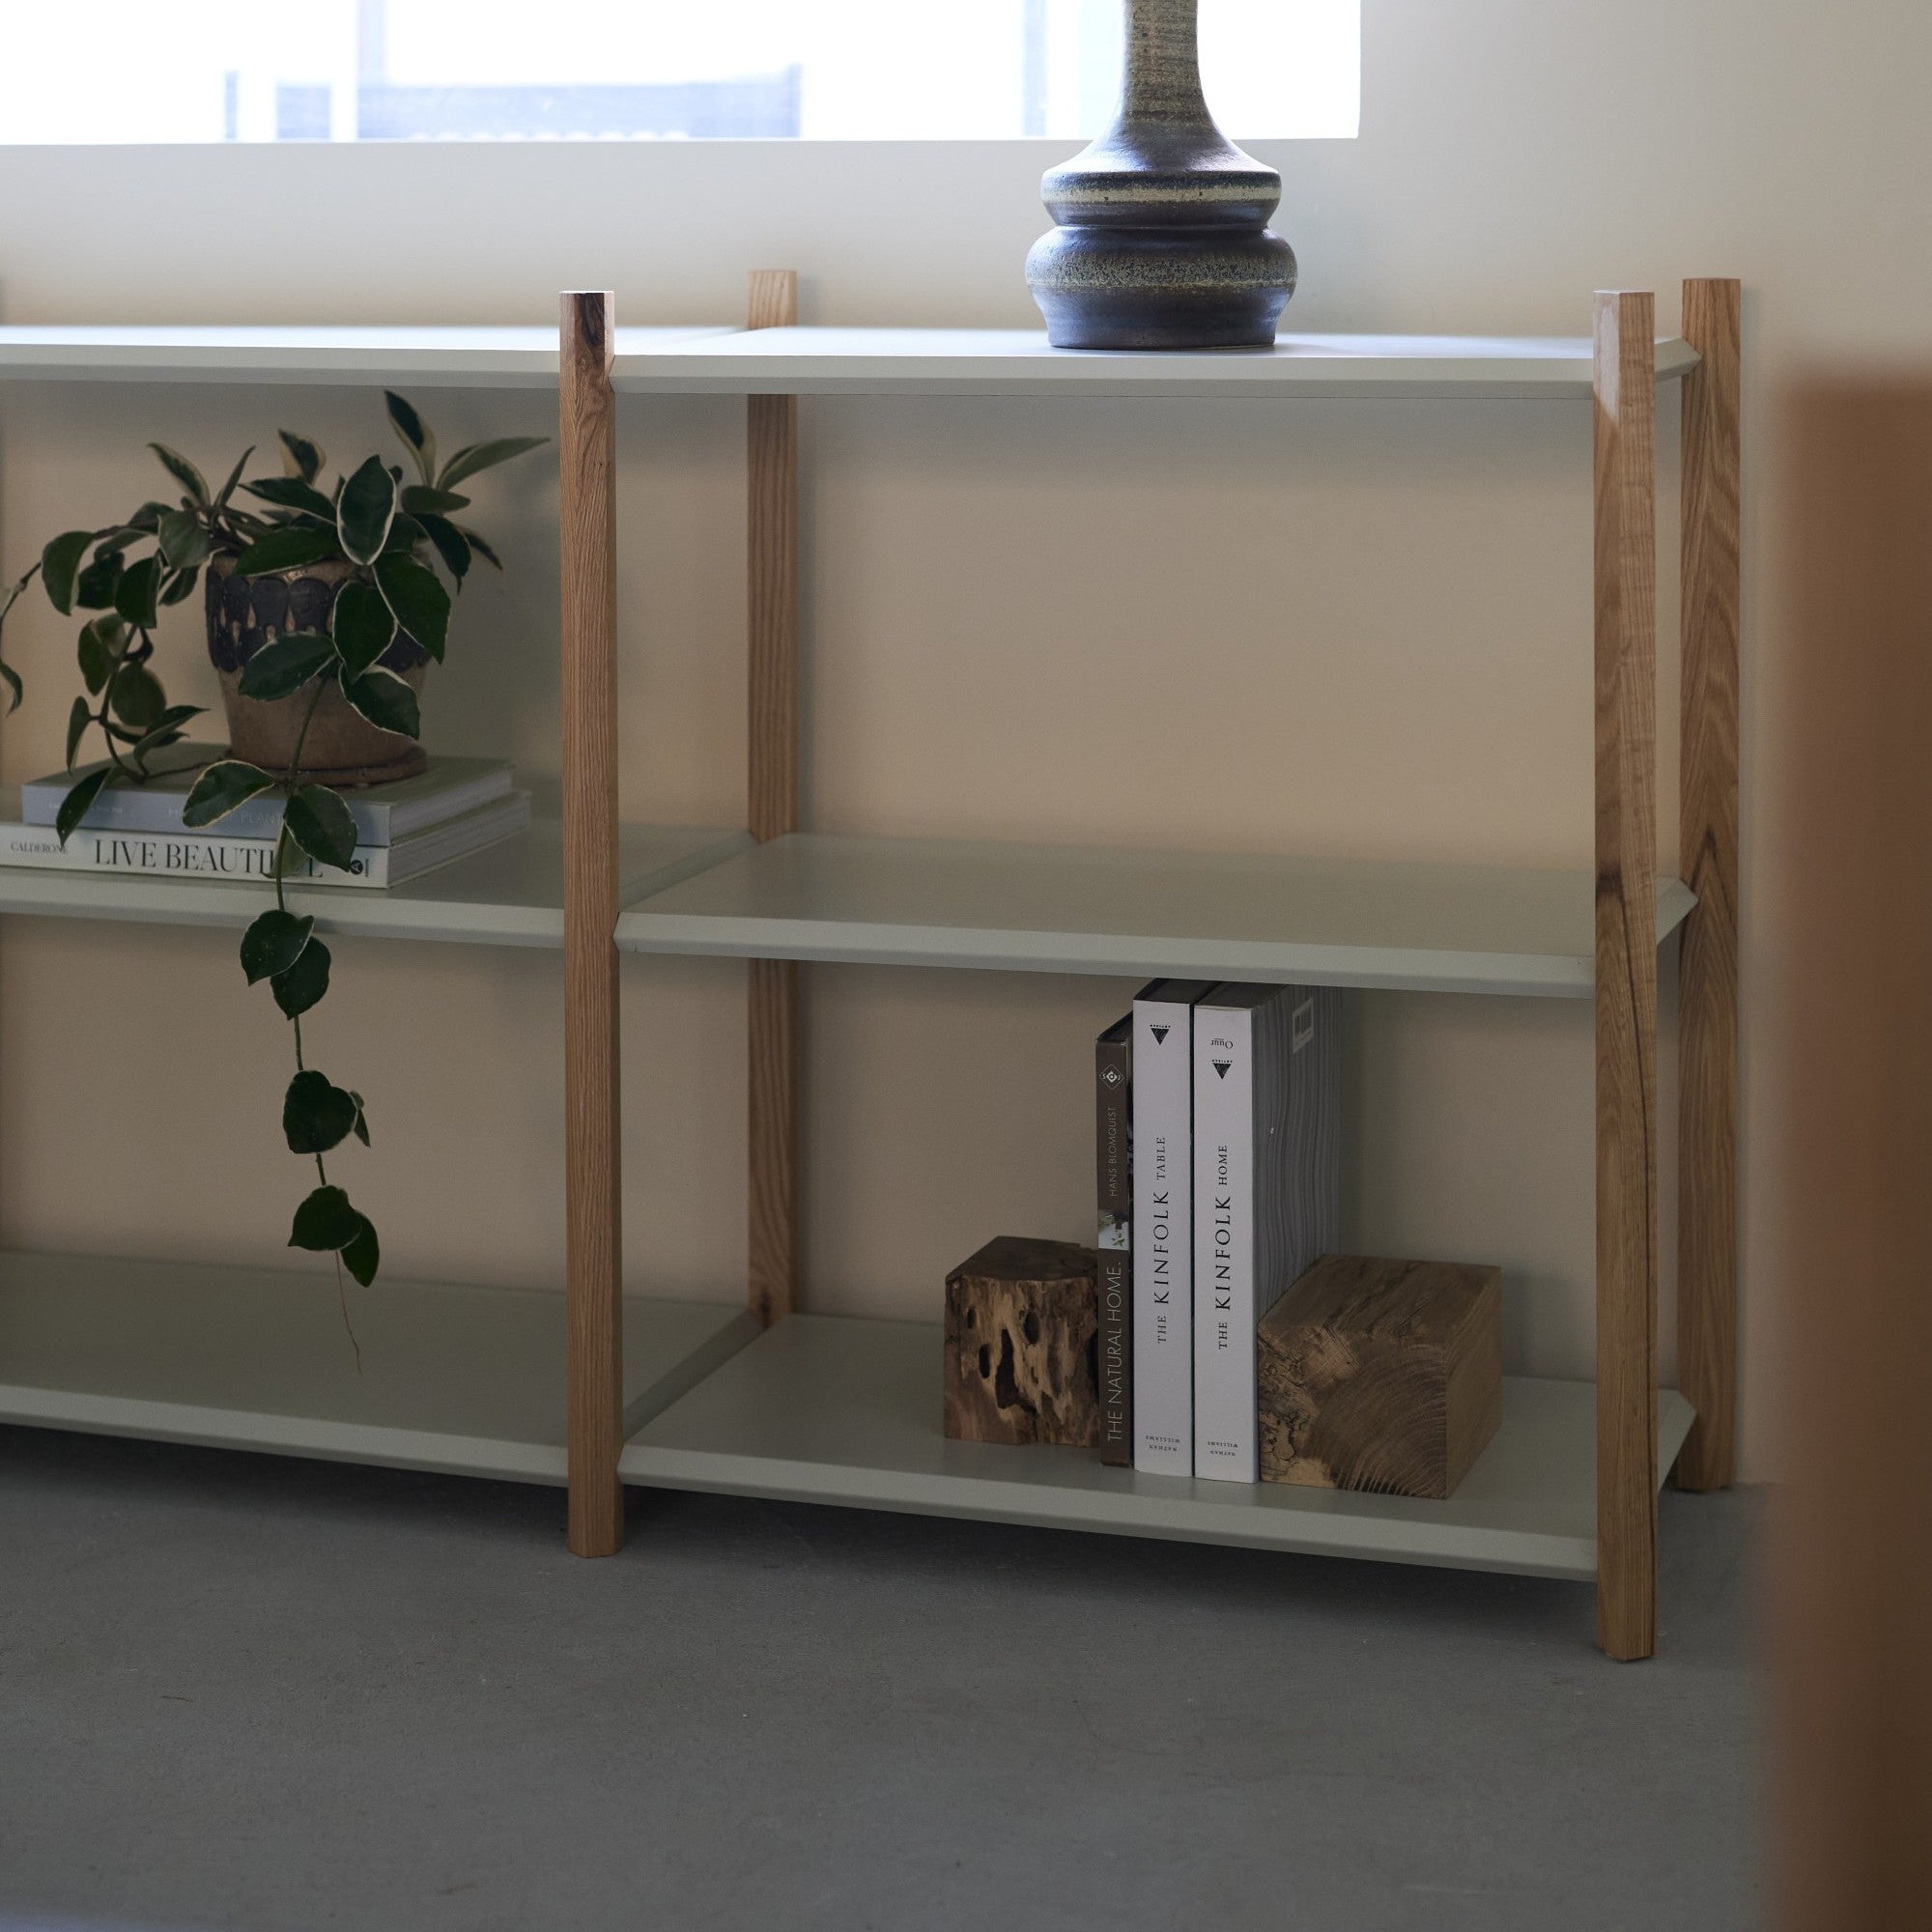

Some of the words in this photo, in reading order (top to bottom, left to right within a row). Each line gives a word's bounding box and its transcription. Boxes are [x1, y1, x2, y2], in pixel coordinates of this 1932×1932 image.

[96, 839, 156, 867] LIVE
[165, 842, 323, 878] BEAUTIL
[1210, 1038, 1234, 1050] Ouur
[1108, 1107, 1118, 1164] BLOMQUIST
[1155, 1137, 1166, 1180] TABLE
[1217, 1145, 1228, 1186] HOME
[1109, 1168, 1119, 1197] HANS
[1153, 1191, 1169, 1305] KINFOLK
[1215, 1196, 1231, 1311] KINFOLK
[1106, 1262, 1122, 1321] HOME.
[1157, 1316, 1167, 1344] THE
[1218, 1321, 1228, 1350] THE
[1107, 1328, 1122, 1405] NATURAL
[1107, 1410, 1122, 1442] THE
[1145, 1435, 1180, 1444] WILLIAMS
[1207, 1440, 1238, 1449] WILLIAMS
